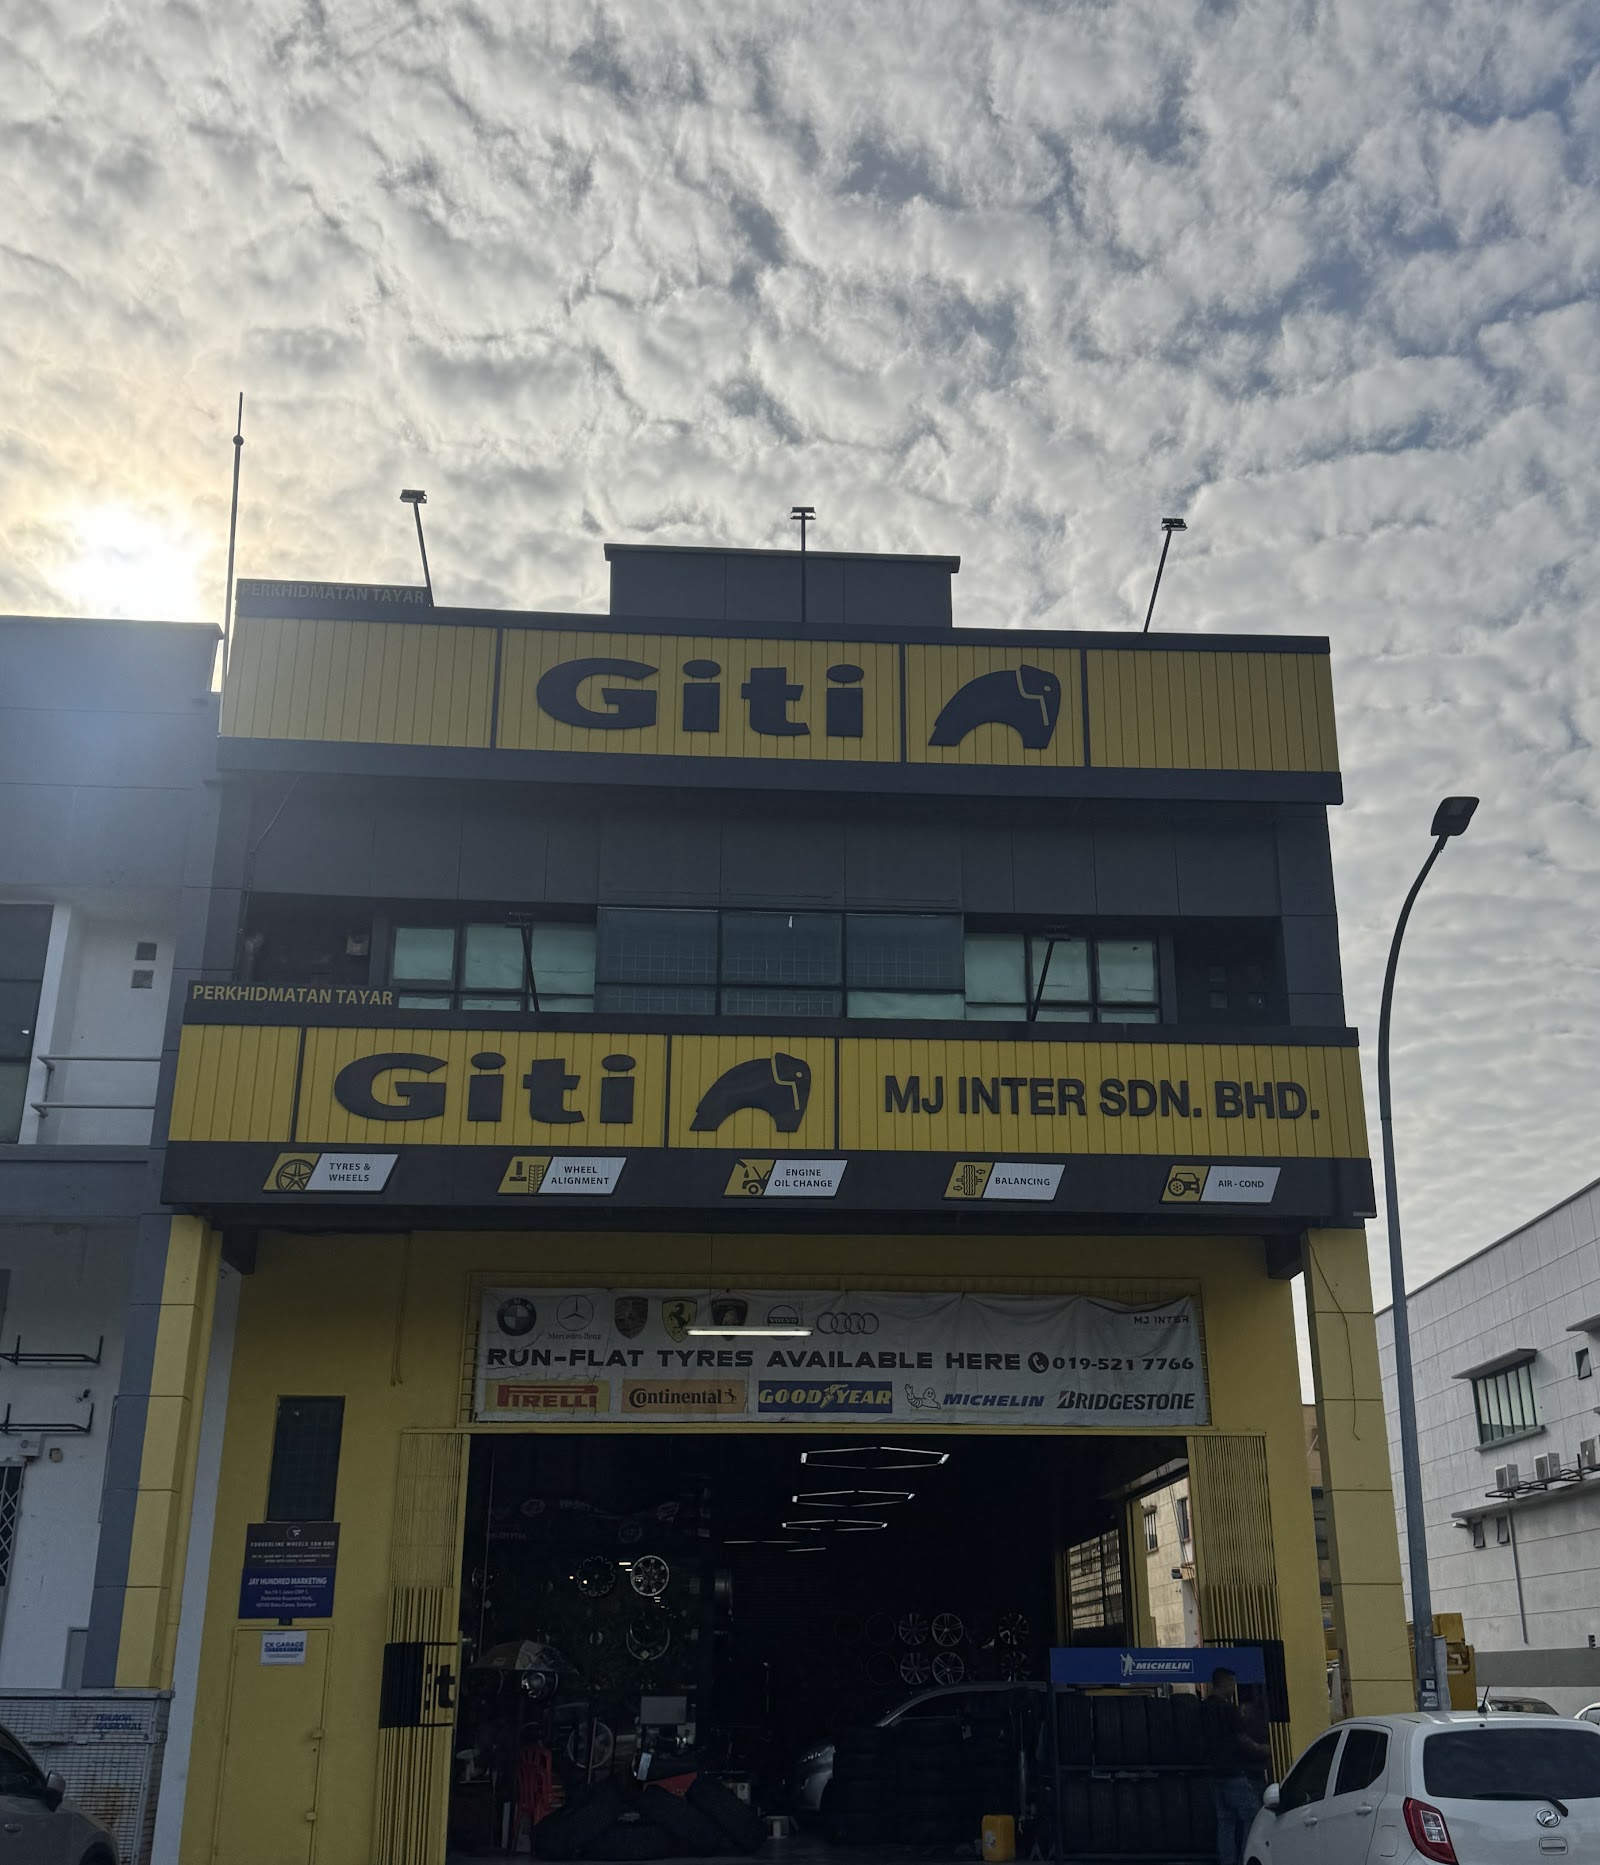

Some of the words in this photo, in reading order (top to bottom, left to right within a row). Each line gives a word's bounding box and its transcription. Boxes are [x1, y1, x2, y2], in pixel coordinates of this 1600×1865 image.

[241, 582, 368, 601] PERKHIDMATAN
[373, 588, 425, 604] TAYAR
[536, 657, 865, 738] Giti
[193, 985, 332, 1004] PERKHIDMATAN
[336, 989, 393, 1006] TAYAR
[334, 1051, 637, 1125] Giti
[884, 1075, 944, 1114] MJ
[959, 1076, 1087, 1117] INTER
[1099, 1078, 1202, 1118] SDN.
[1215, 1080, 1321, 1120] BHD.
[329, 1162, 362, 1171] TYRES
[363, 1163, 371, 1171] &
[564, 1165, 598, 1174] WHEEL
[785, 1168, 822, 1177] ENGINE
[328, 1174, 370, 1182] WHEELS
[551, 1176, 610, 1185] ALIGNMENT
[774, 1179, 790, 1188] OIL
[792, 1179, 833, 1188] CHANGE
[995, 1177, 1051, 1187] BALANCING
[1134, 1316, 1150, 1325] MJ
[1154, 1315, 1190, 1324] INTER
[487, 1349, 643, 1367] RUN-FLAT
[657, 1350, 754, 1368] TYRES
[766, 1350, 933, 1369] AVAILABLE
[946, 1352, 1021, 1371] HERE
[1052, 1357, 1135, 1371] 019-521
[1143, 1357, 1195, 1371] 7766
[497, 1385, 599, 1409] PIRELLI
[629, 1387, 723, 1408] Continental
[759, 1386, 893, 1407] GOODYEAR
[943, 1393, 1045, 1407] MICHELIN
[1056, 1390, 1196, 1410] BRIDGESTONE
[260, 1577, 291, 1585] HUNDRED
[291, 1577, 328, 1585] MARKETING
[1136, 1662, 1191, 1670] MICHELIN
